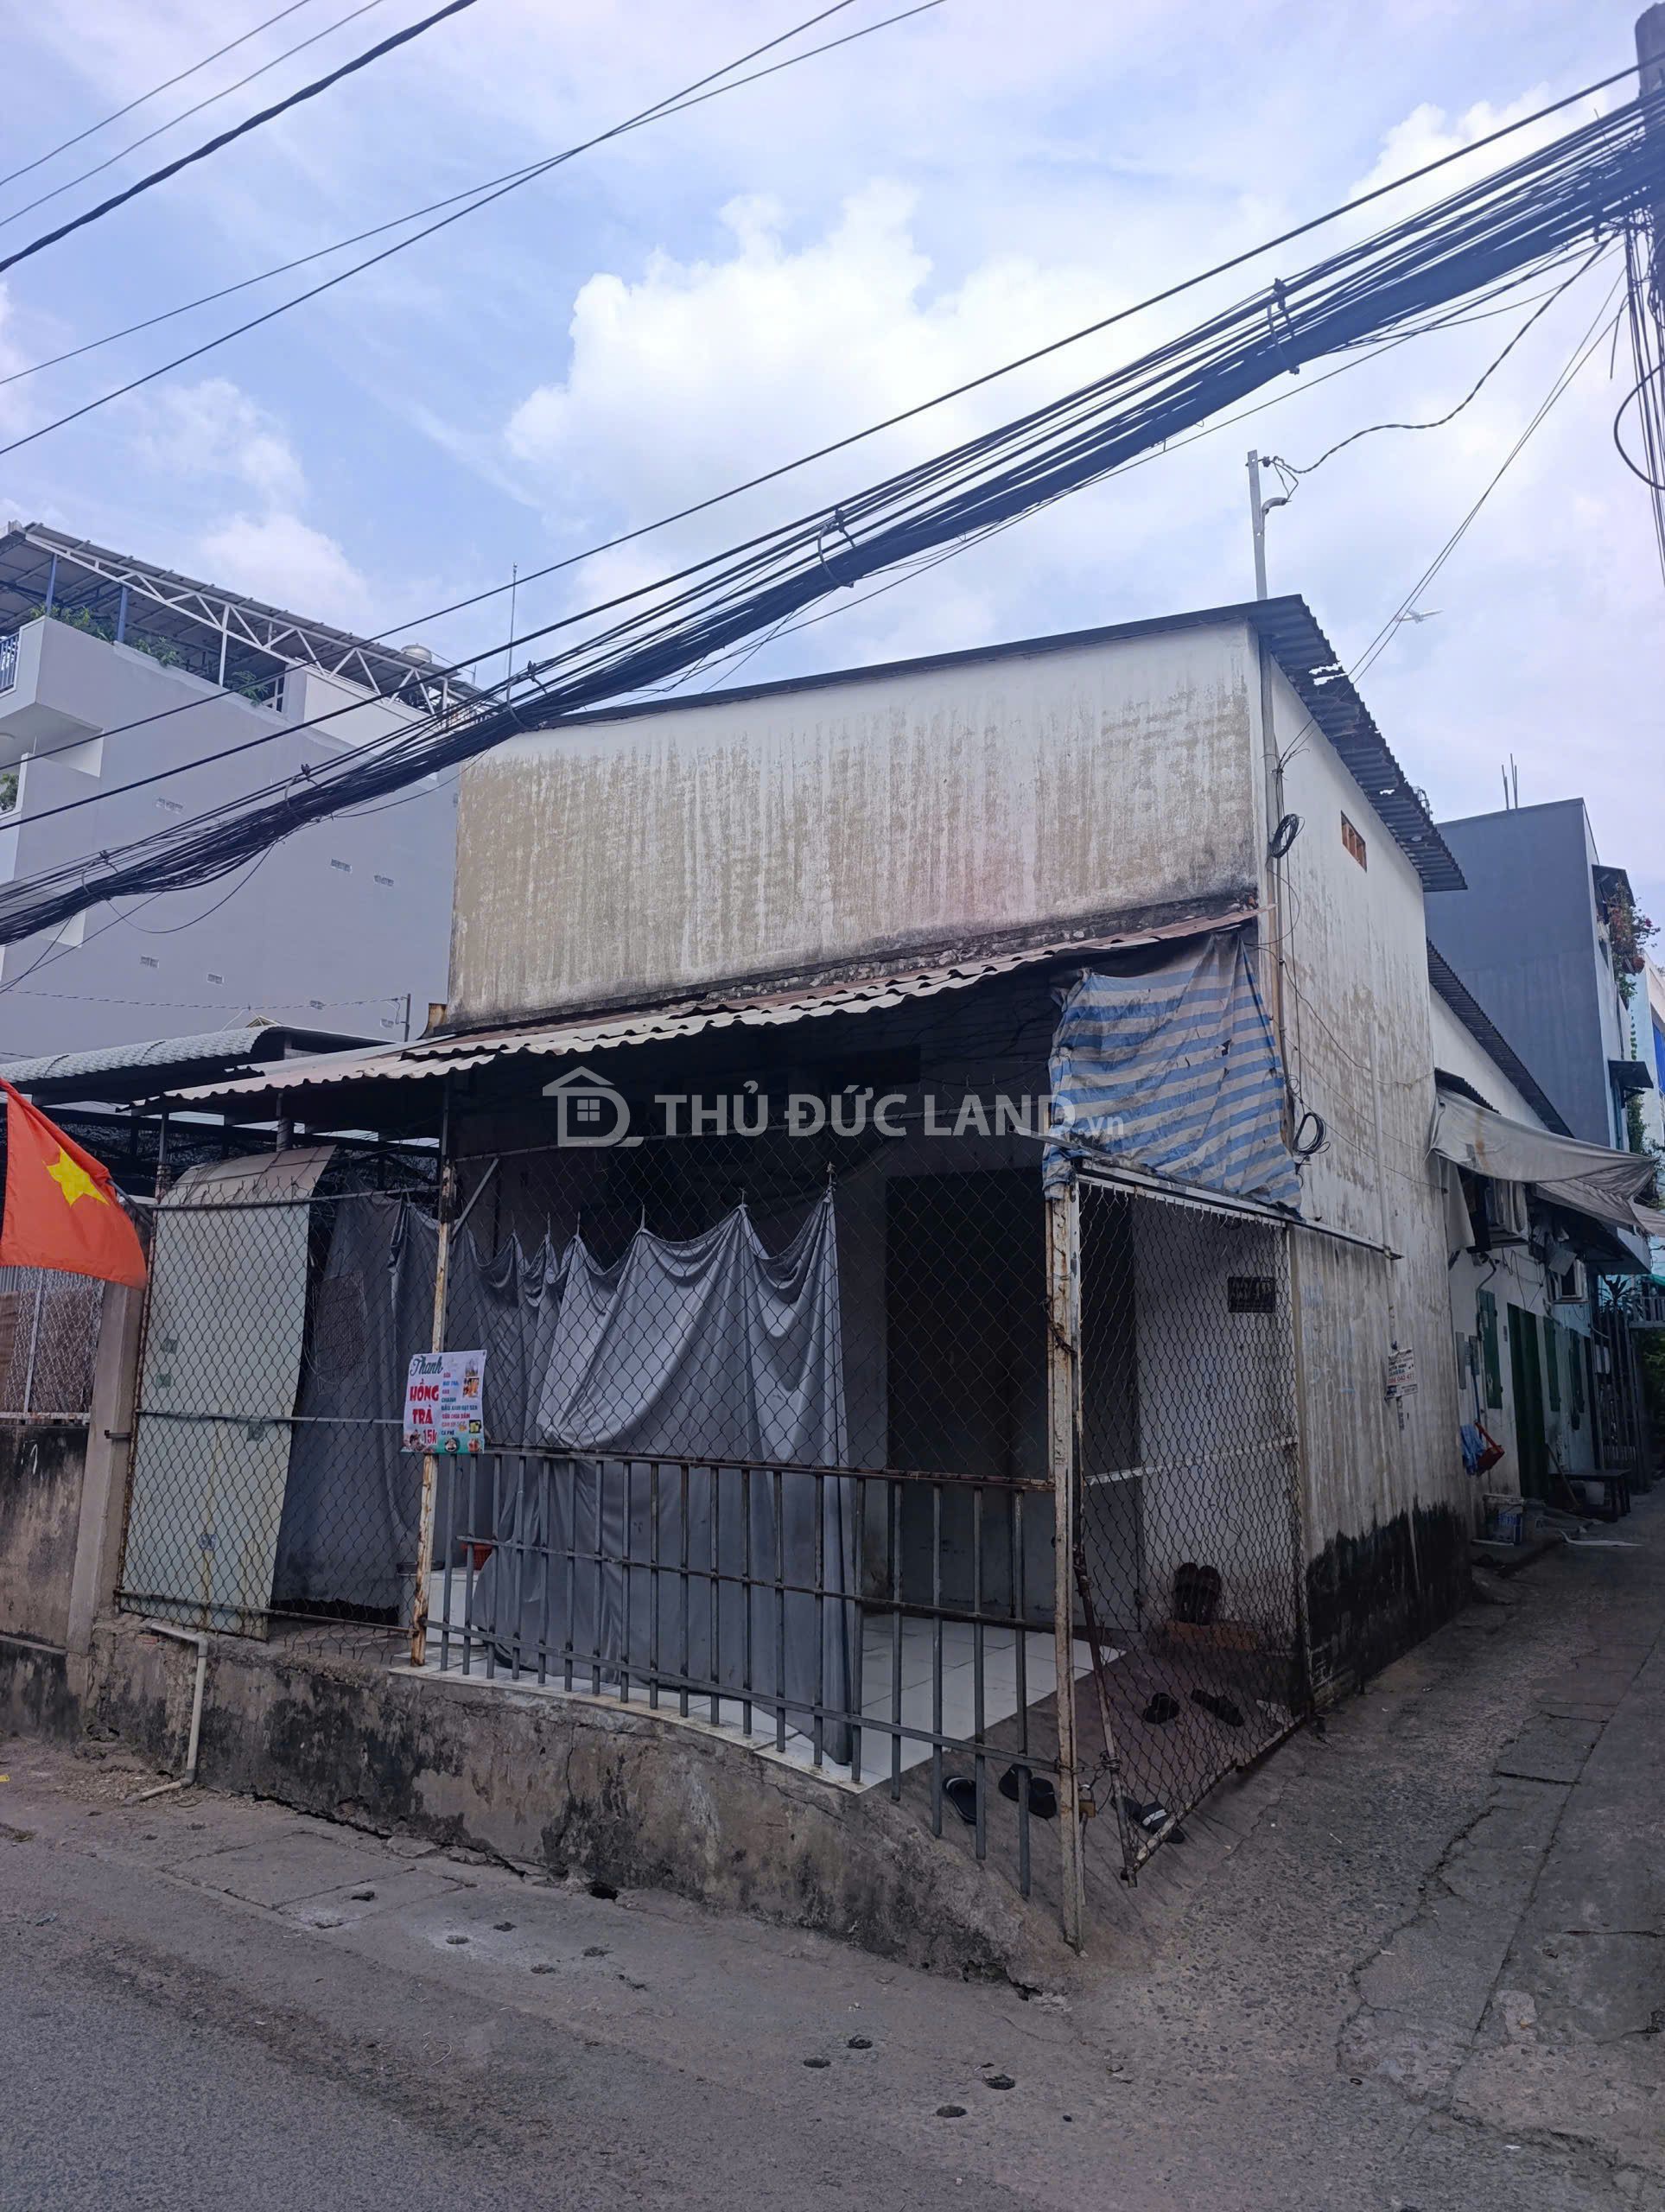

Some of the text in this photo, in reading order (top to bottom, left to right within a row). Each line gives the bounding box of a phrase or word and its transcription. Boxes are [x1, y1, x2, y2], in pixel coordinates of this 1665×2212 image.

[410, 1355, 443, 1376] Thanh
[410, 1378, 439, 1402] HỒNG
[412, 1405, 433, 1425] TRÀ
